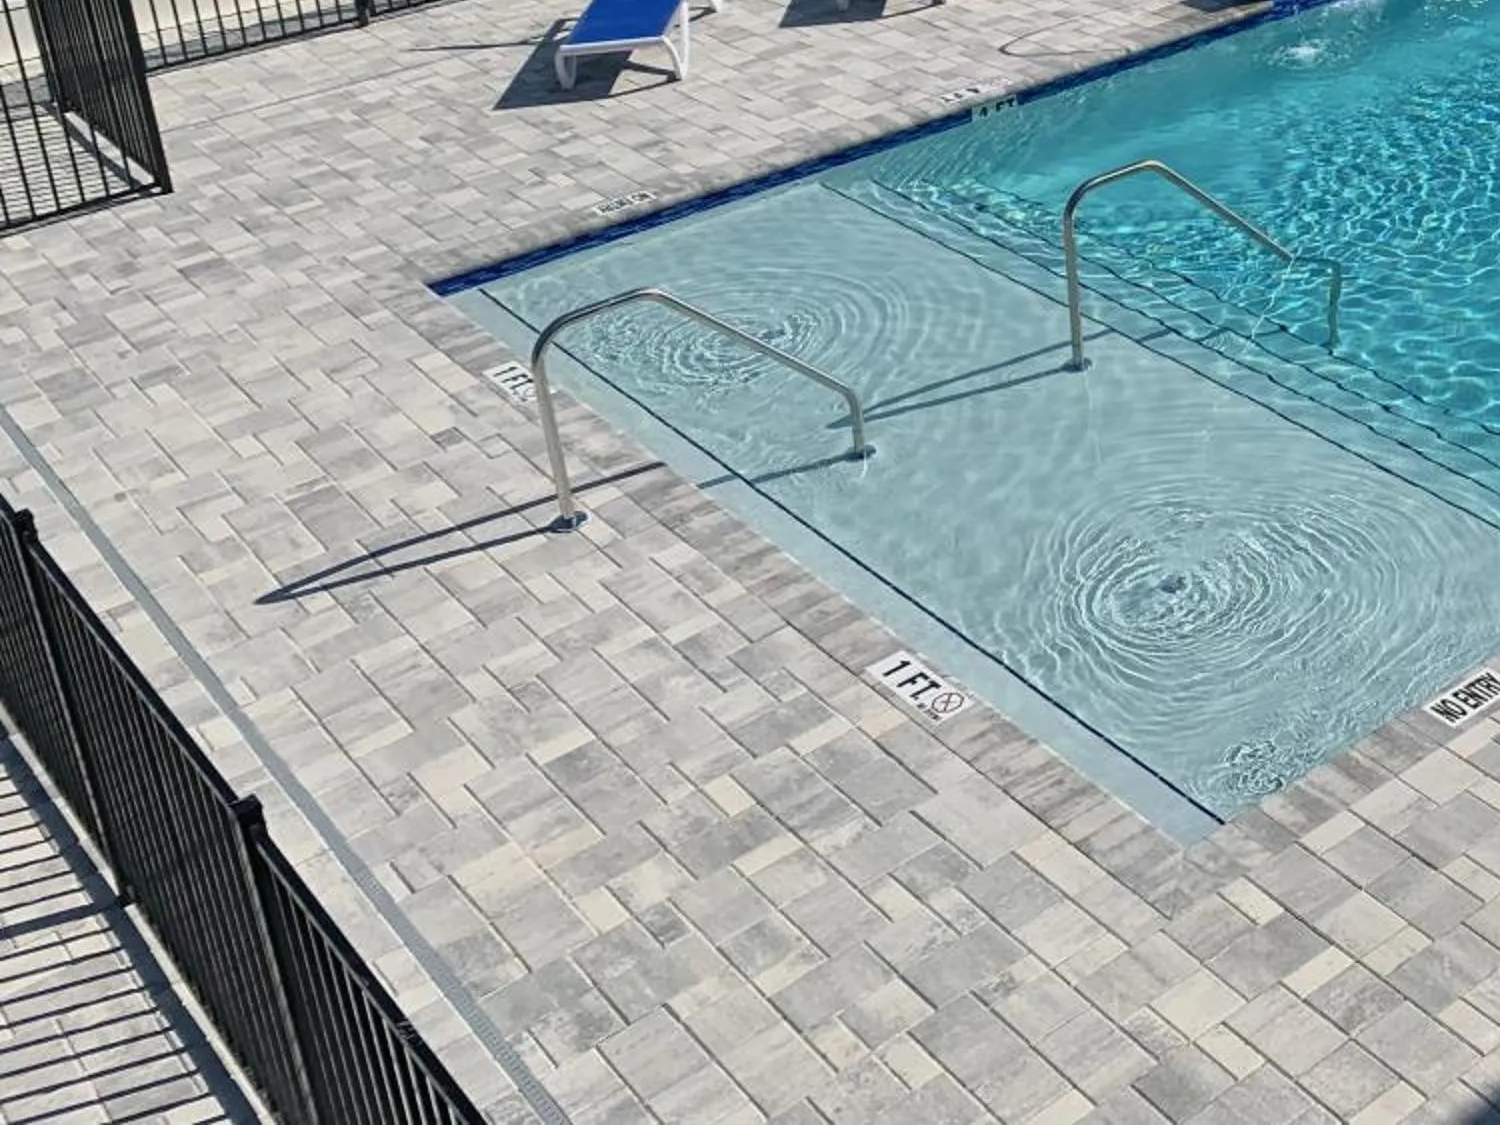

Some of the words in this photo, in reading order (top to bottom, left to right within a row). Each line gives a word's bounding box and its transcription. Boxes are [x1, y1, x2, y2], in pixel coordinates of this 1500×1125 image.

[493, 366, 518, 377] 1
[883, 659, 912, 677] 1
[1429, 700, 1468, 723] NO
